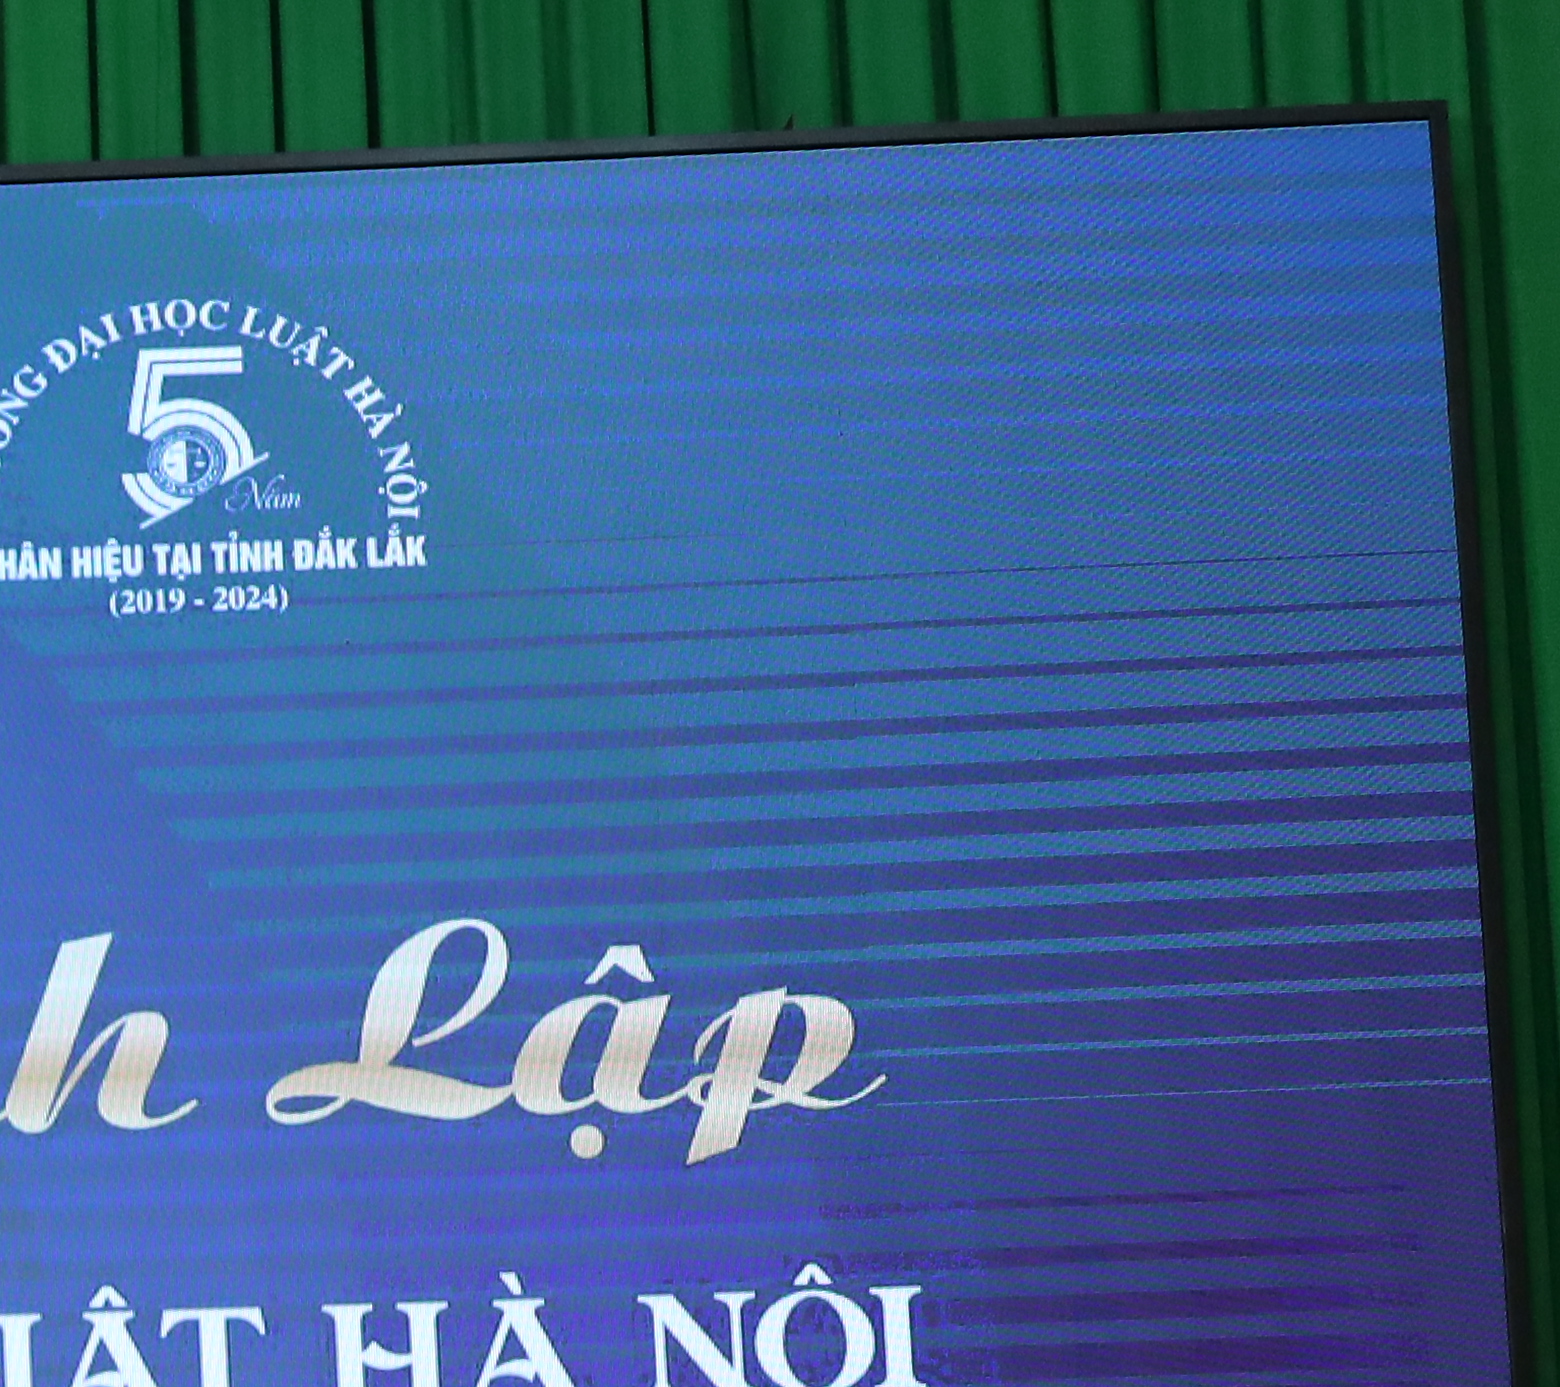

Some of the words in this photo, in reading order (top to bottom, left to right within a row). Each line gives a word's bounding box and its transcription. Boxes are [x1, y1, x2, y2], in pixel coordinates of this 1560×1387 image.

[41, 312, 122, 374] ĐẠI
[129, 298, 231, 337] HỌC
[240, 305, 355, 379] LUẬT
[343, 375, 405, 439] HÀ
[377, 440, 429, 520] NỘI
[121, 345, 270, 530] 5
[71, 538, 145, 579] HIỆU
[152, 542, 203, 580] TẠI
[212, 529, 285, 573] TỈNH
[292, 524, 359, 571] ĐẮK
[366, 522, 428, 568] LẮK
[108, 588, 187, 618] (2019
[211, 584, 290, 614] 2024)
[264, 917, 888, 1166] Lập
